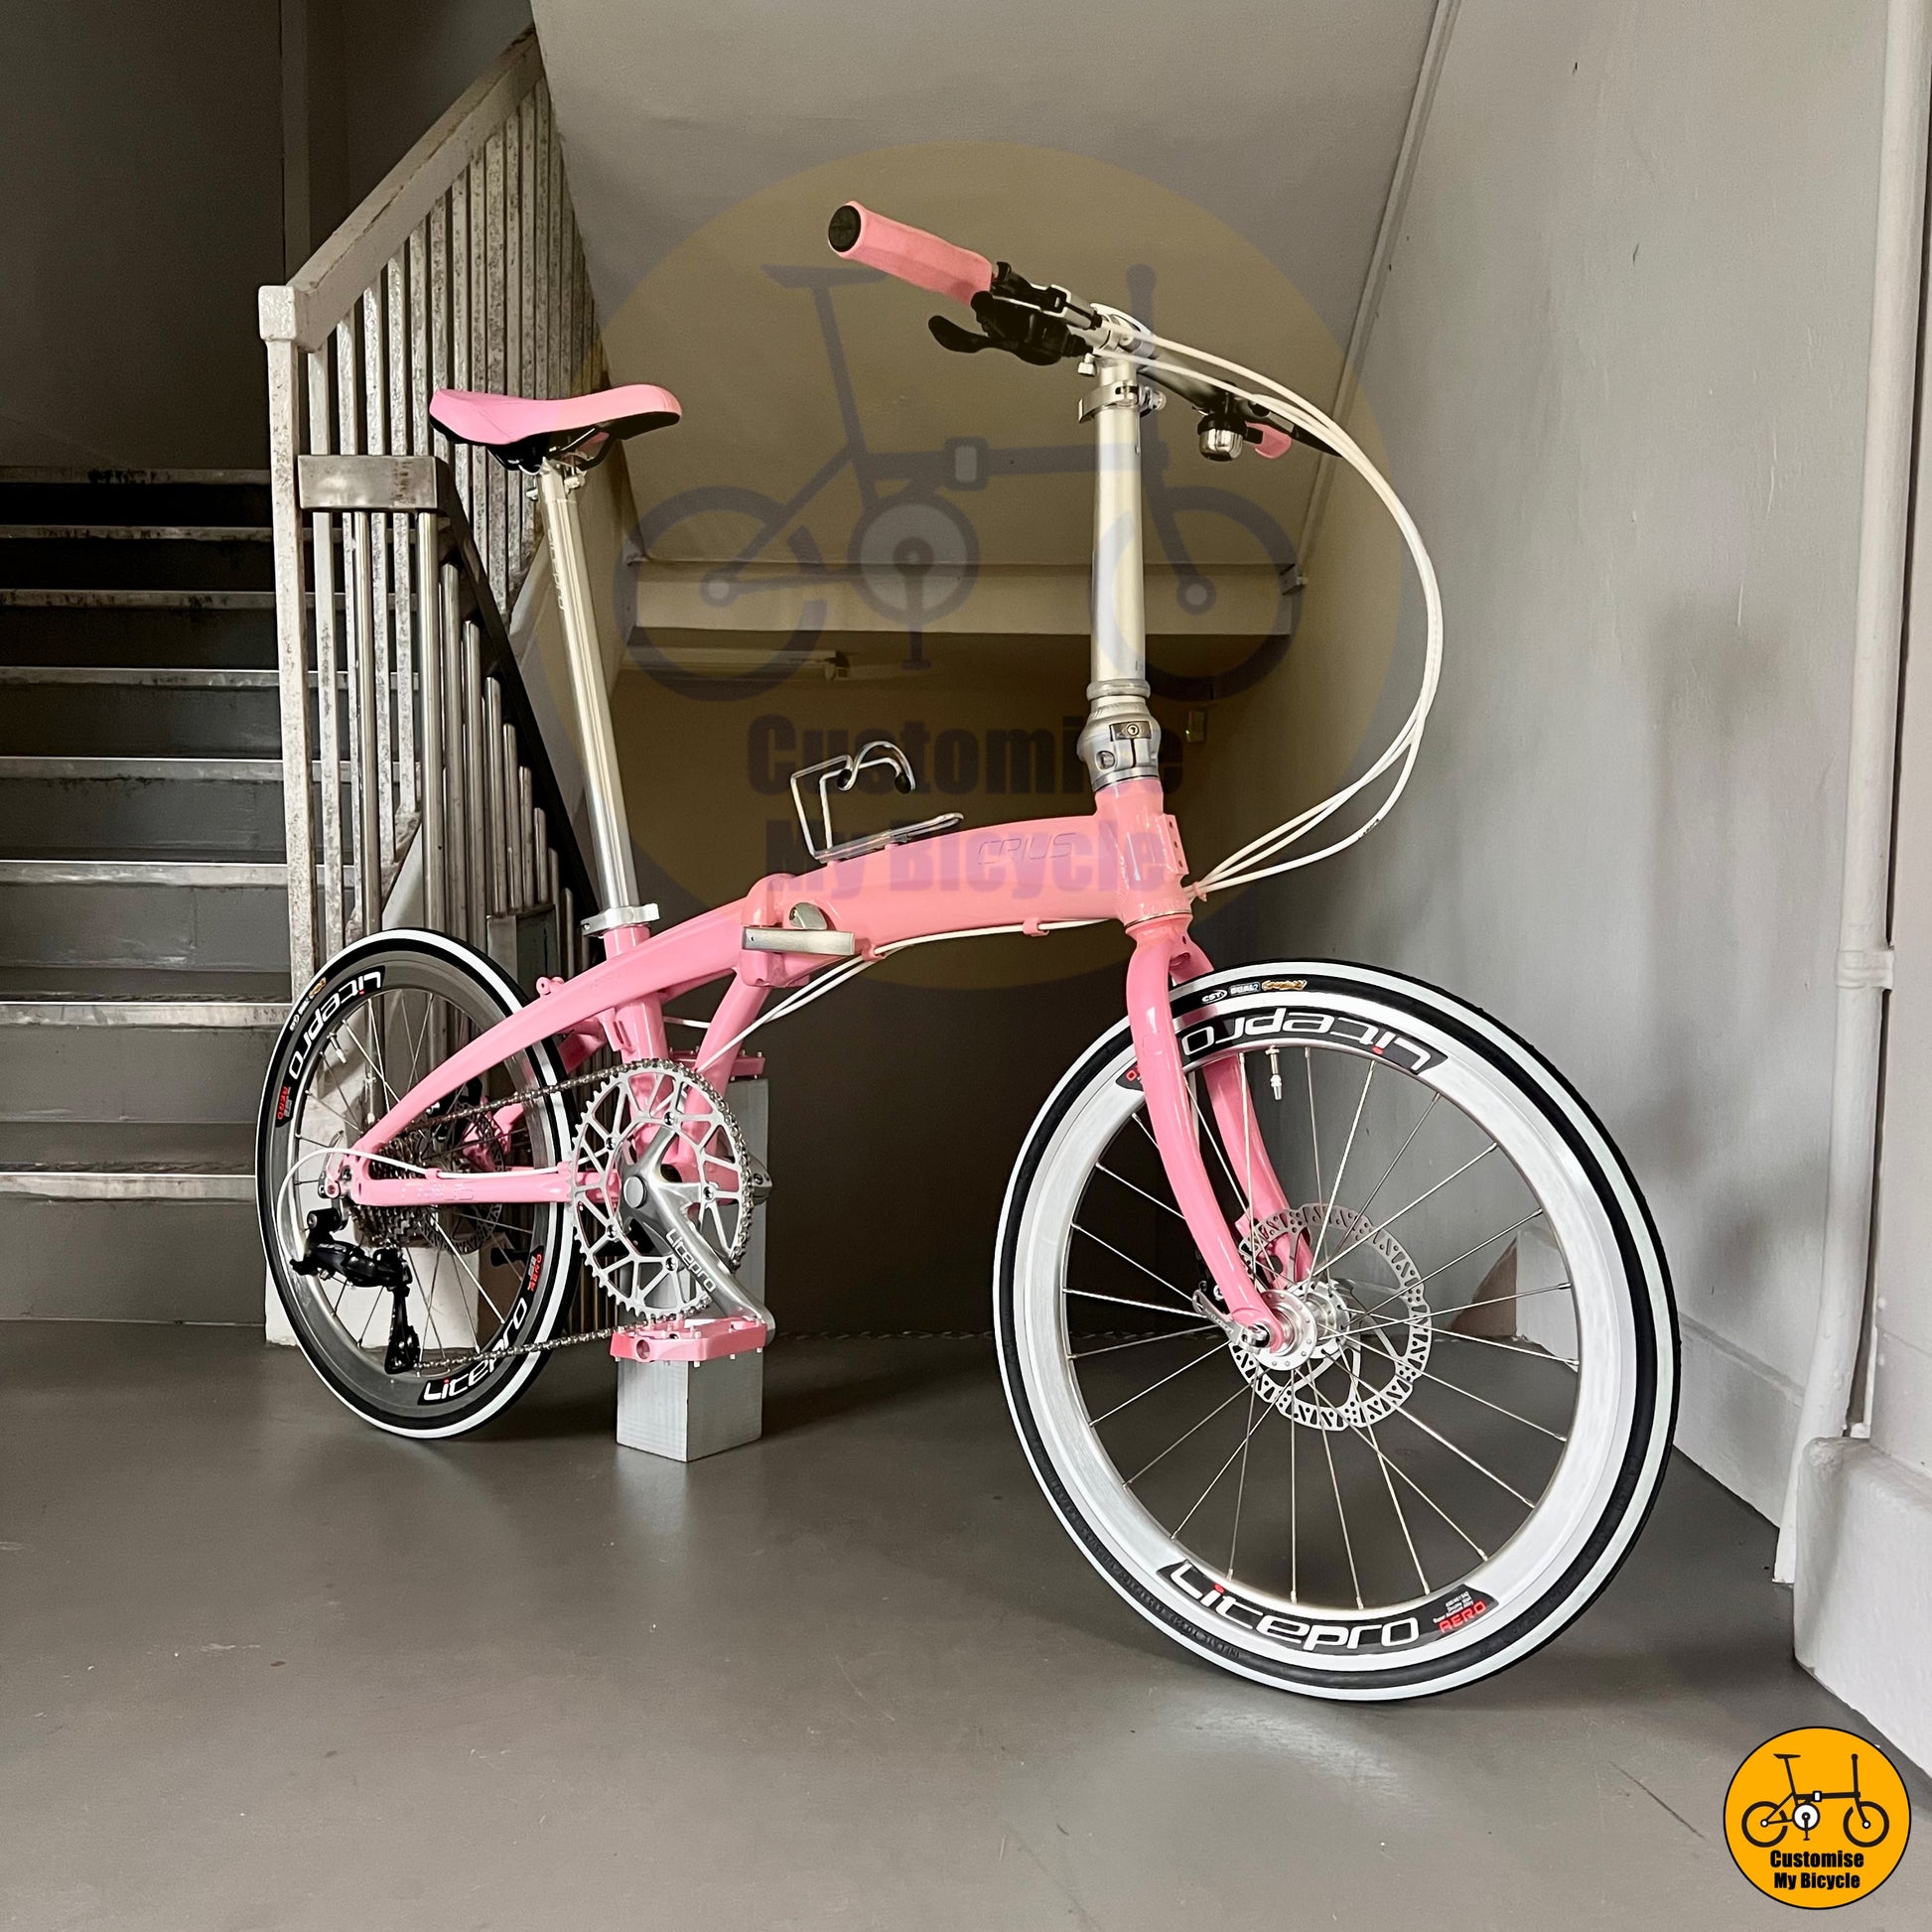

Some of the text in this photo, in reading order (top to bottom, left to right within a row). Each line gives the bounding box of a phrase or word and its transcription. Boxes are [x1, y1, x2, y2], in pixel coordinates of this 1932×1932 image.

[977, 832, 1077, 866] CRIUS
[289, 971, 381, 1080] Litepro
[1181, 1008, 1432, 1070] Litepro
[666, 1228, 716, 1293] Litepro
[1171, 1564, 1420, 1652] Litepro
[1439, 1600, 1486, 1634] AERO
